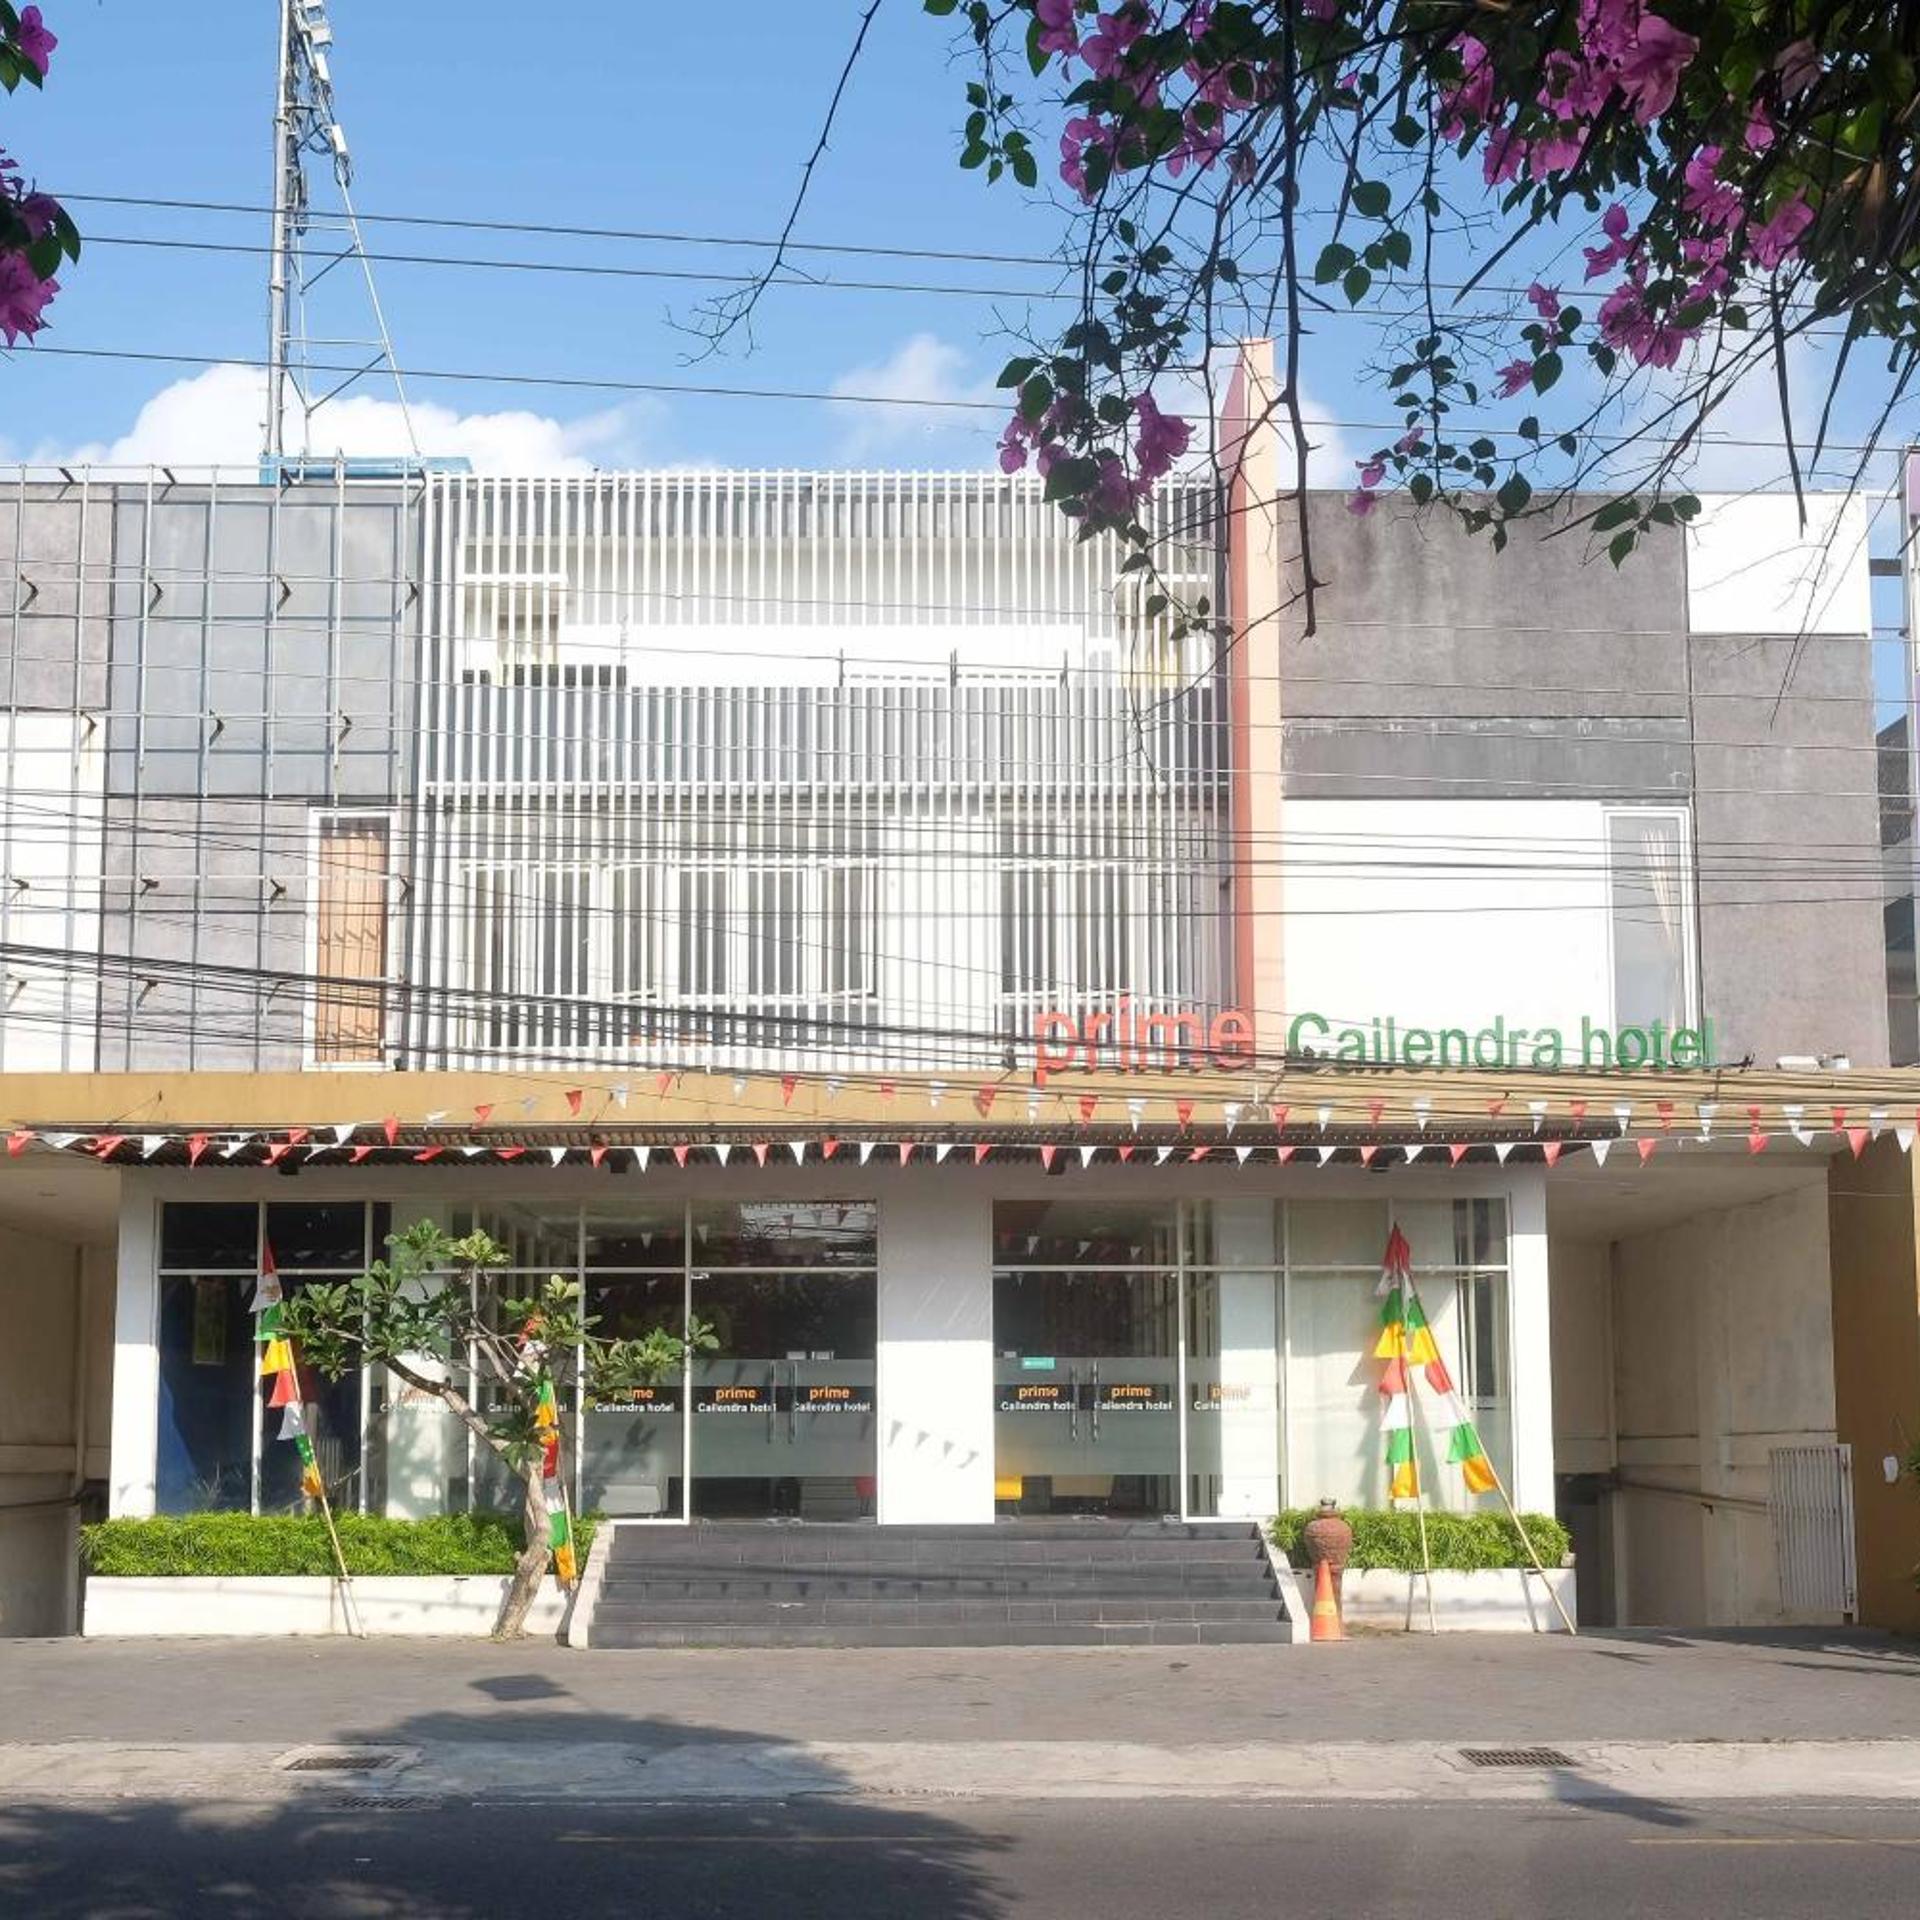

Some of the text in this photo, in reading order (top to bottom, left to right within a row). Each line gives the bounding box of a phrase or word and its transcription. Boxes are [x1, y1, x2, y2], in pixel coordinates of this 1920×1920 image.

[1034, 994, 1715, 1089] prime Cailendra hotel
[715, 1385, 756, 1402] prime
[809, 1385, 850, 1401] prime
[1018, 1385, 1059, 1401] prime
[1110, 1383, 1152, 1399] prime
[1145, 1400, 1173, 1411] hotel
